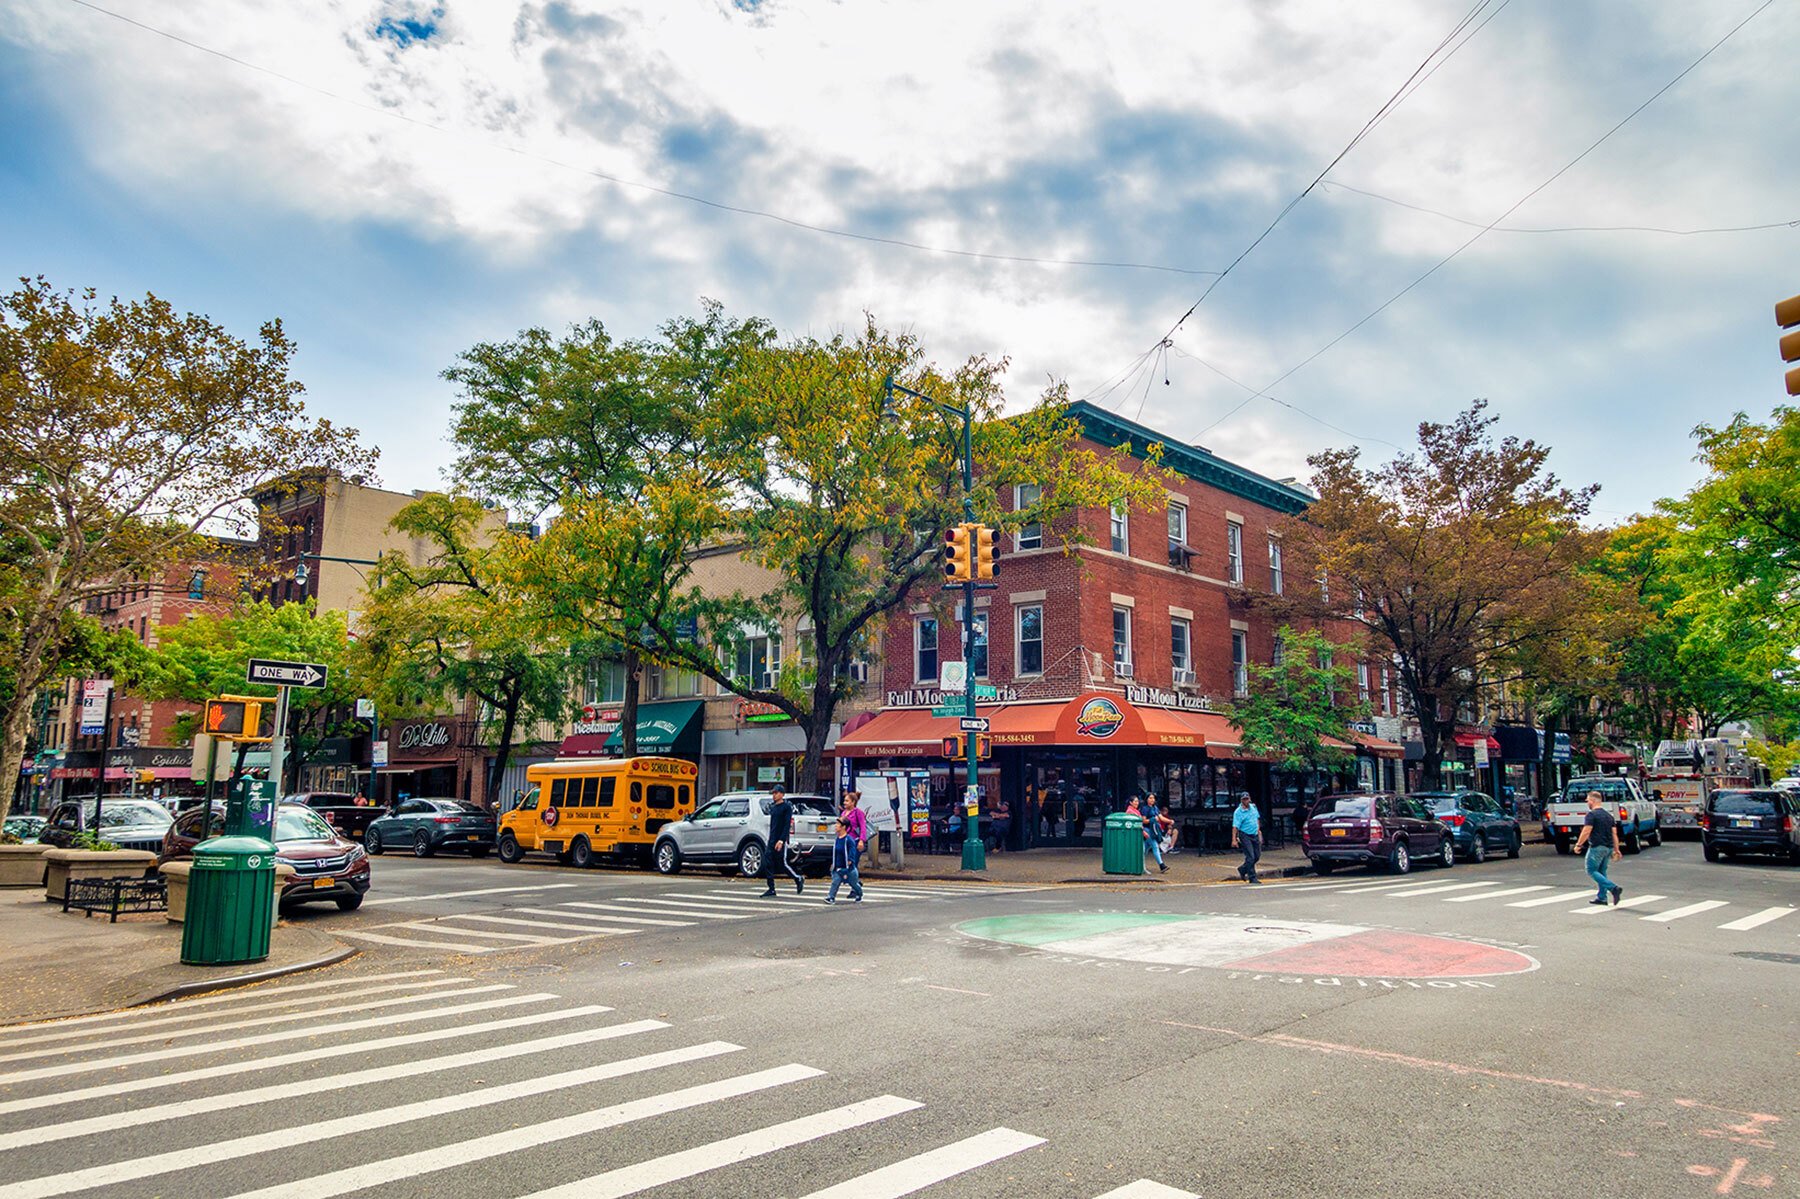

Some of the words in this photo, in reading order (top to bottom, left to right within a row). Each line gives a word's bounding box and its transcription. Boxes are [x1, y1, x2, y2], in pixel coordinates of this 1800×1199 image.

[260, 667, 283, 678] ONE
[293, 670, 315, 680] WAY
[887, 690, 913, 706] Full
[1126, 685, 1147, 703] Full
[1149, 688, 1177, 706] Moon
[993, 735, 1035, 743] 718-584-3451
[864, 747, 877, 756] Full
[878, 747, 896, 755] Moon
[897, 746, 923, 755] Pizzeria
[152, 754, 185, 767] Egidio
[651, 762, 669, 774] SCHOOL
[670, 764, 680, 775] BUS
[1665, 791, 1687, 799] FDNY
